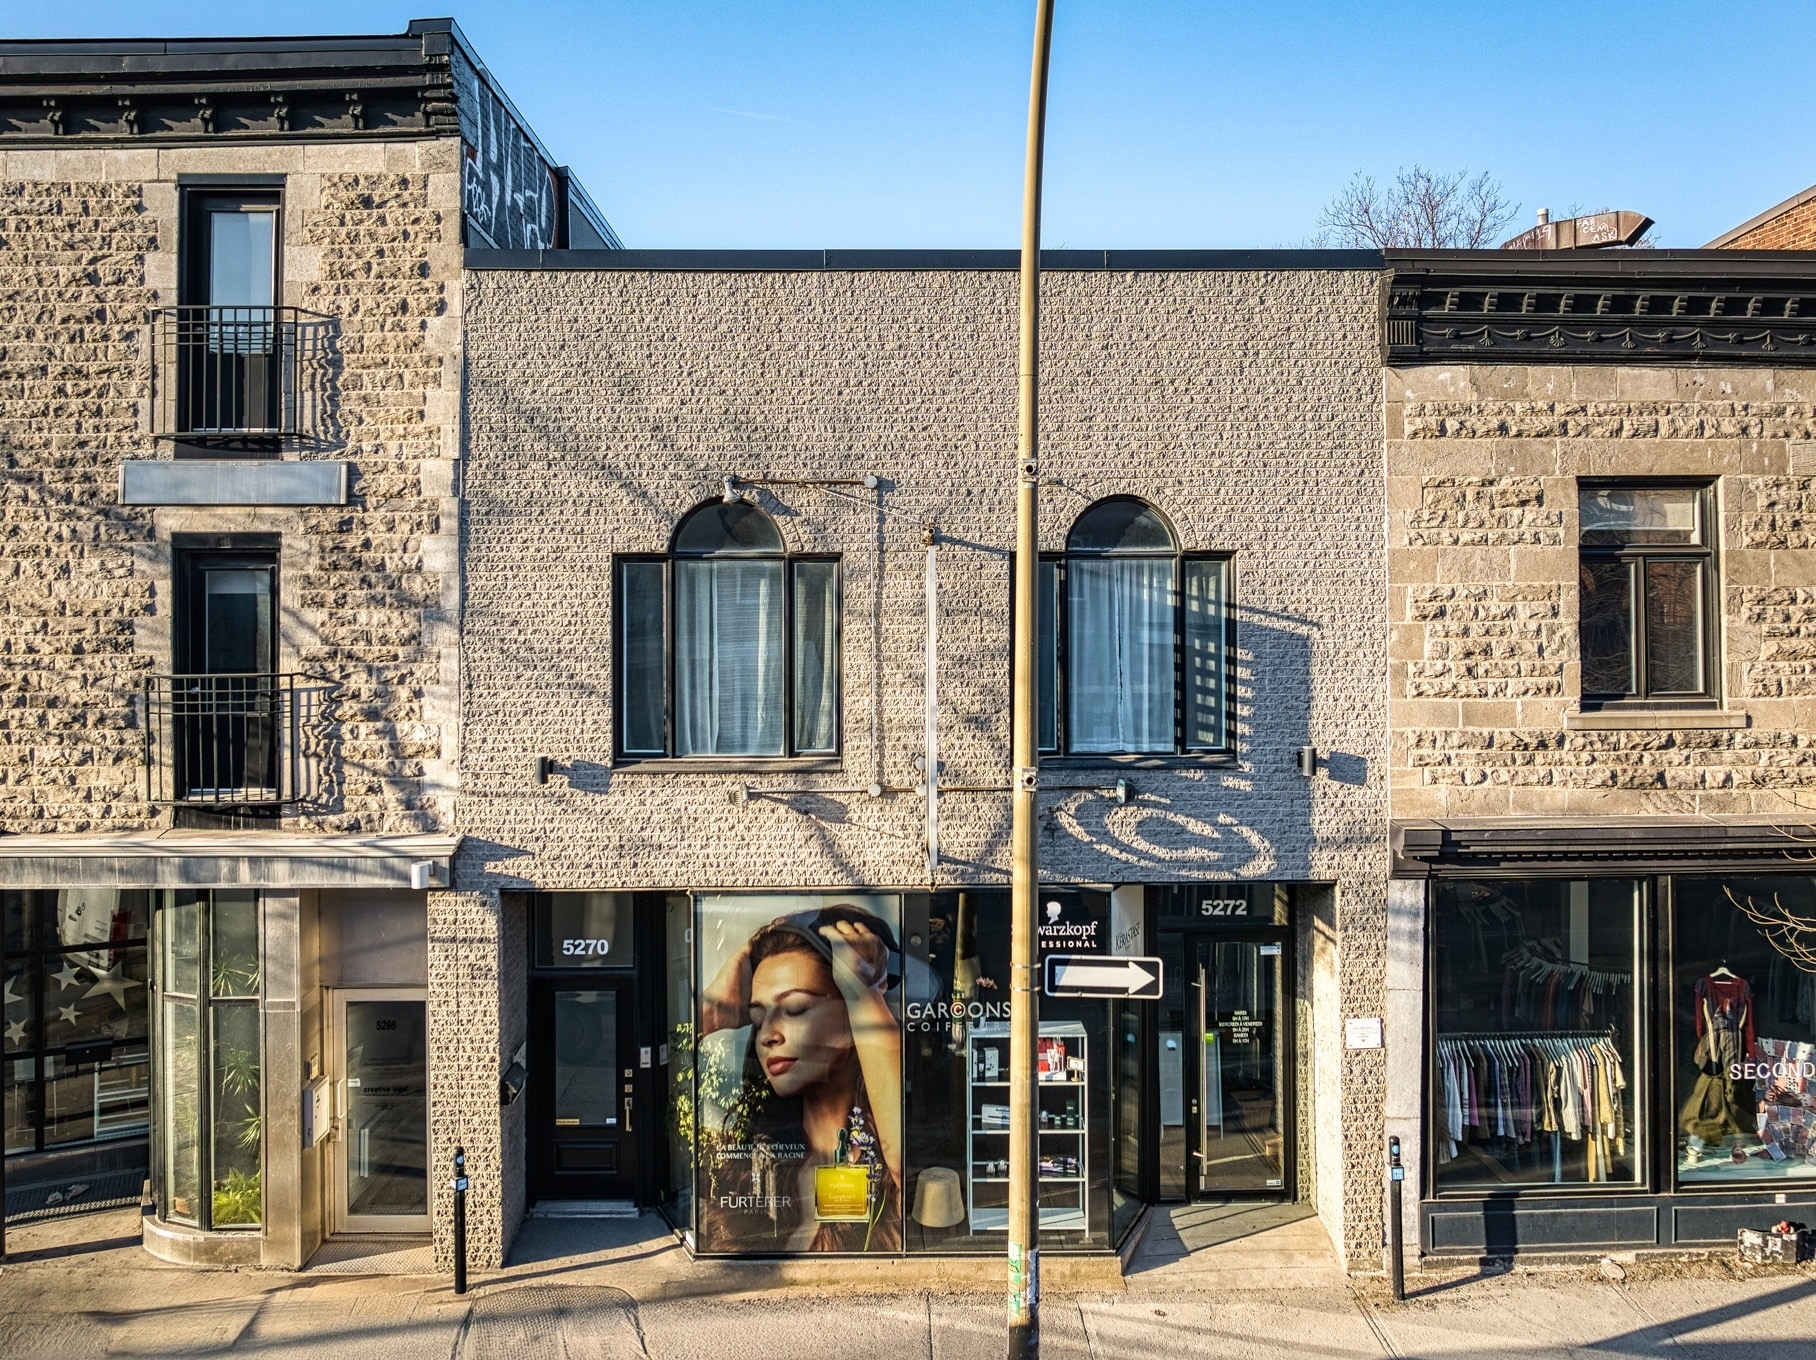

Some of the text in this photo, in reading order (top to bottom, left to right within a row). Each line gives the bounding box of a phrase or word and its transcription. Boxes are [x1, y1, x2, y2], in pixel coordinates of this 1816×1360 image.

[1201, 899, 1247, 916] 5272
[1038, 921, 1098, 940] warzkopf
[562, 939, 609, 955] 5270
[1729, 1062, 1816, 1080] SECOND
